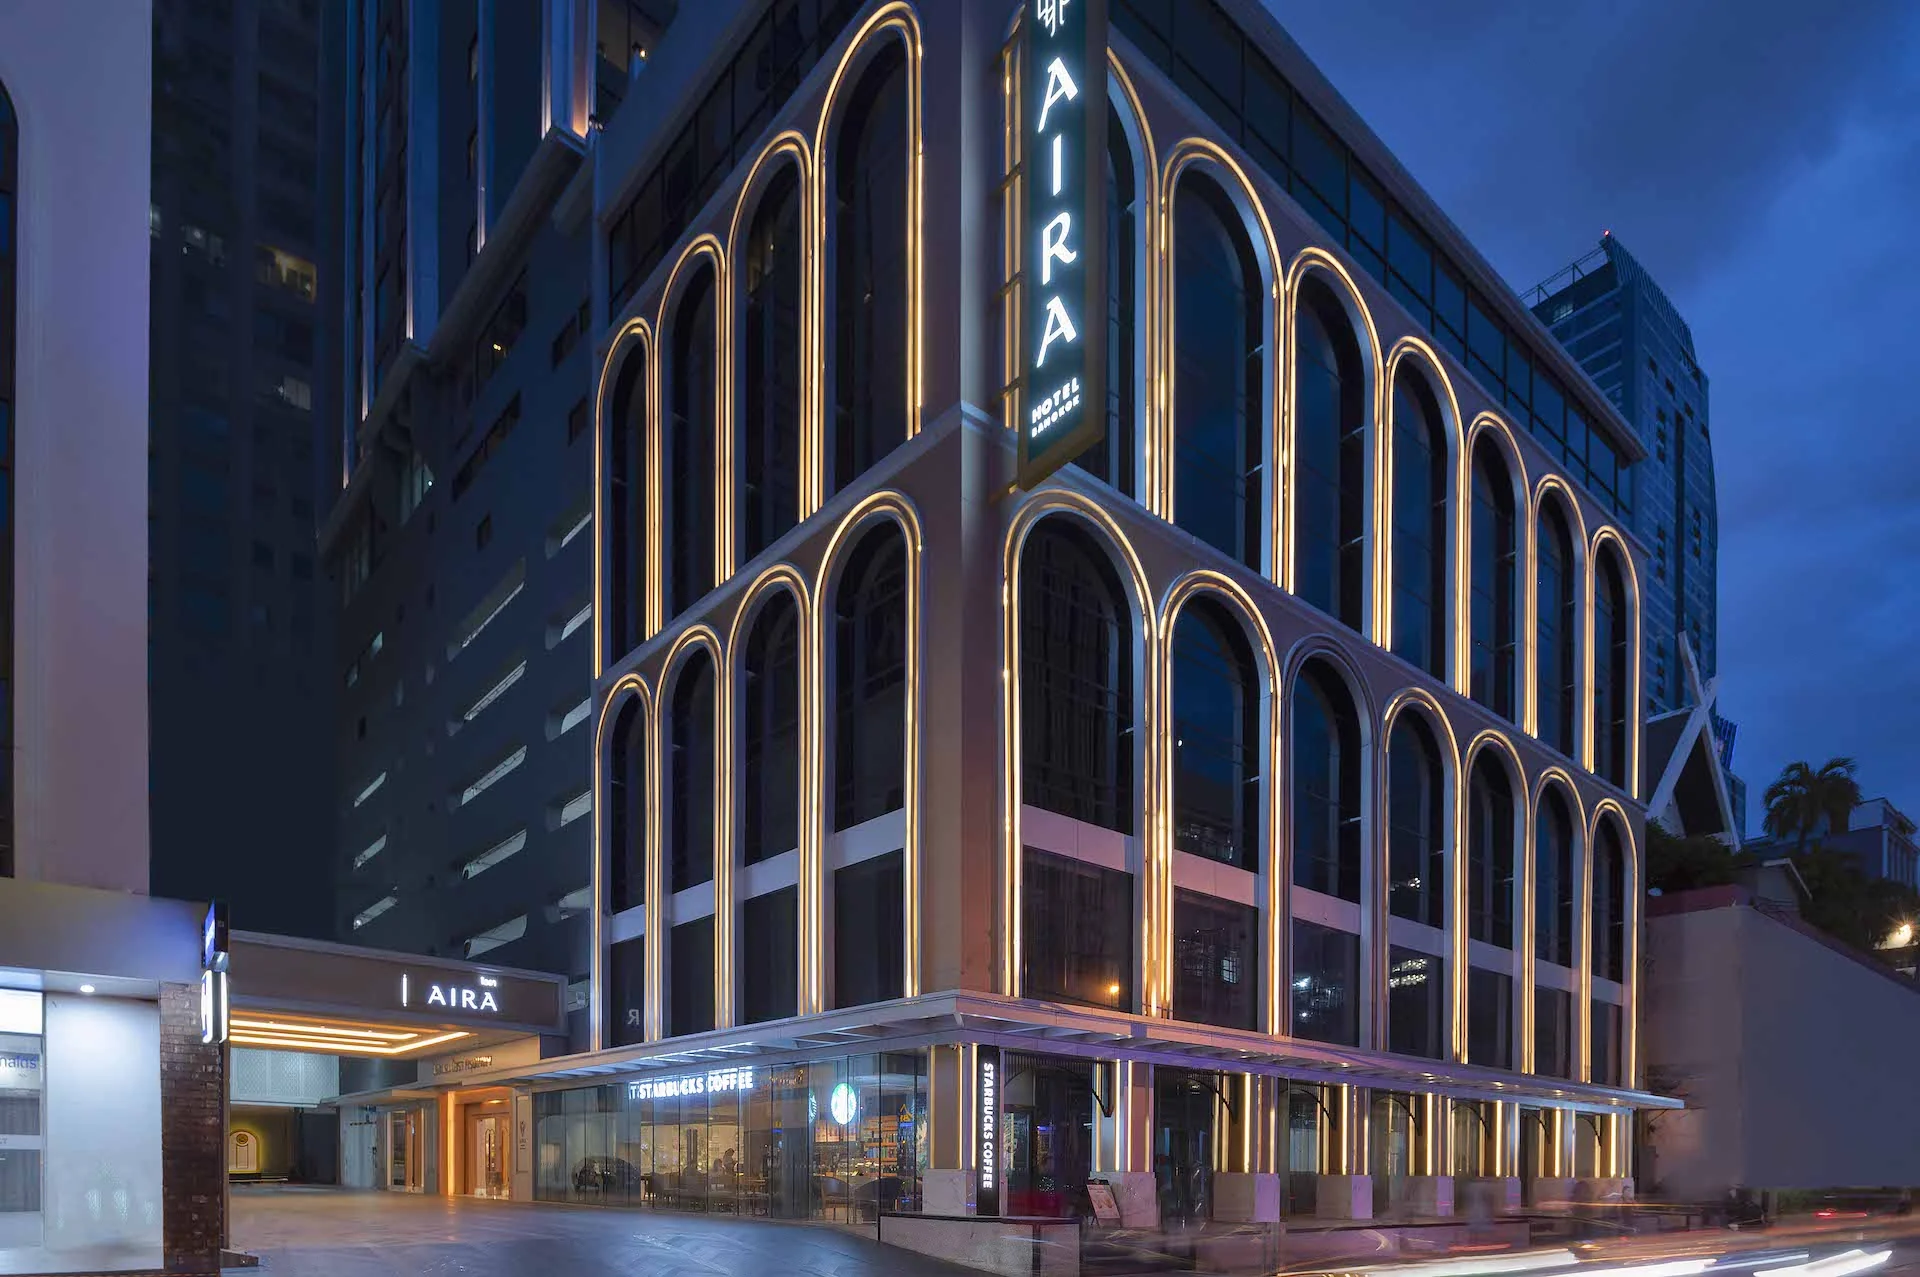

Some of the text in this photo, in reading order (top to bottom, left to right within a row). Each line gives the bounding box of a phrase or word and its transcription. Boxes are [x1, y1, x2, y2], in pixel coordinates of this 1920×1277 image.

[1037, 56, 1078, 369] AIRA
[1031, 377, 1080, 424] HOTEL
[1031, 394, 1080, 438] BANGKOK
[427, 985, 498, 1012] AIRA
[639, 1075, 705, 1099] STARBUCKS
[706, 1070, 754, 1093] COFFEE
[983, 1062, 994, 1189] STARBUCKS COFFEE
